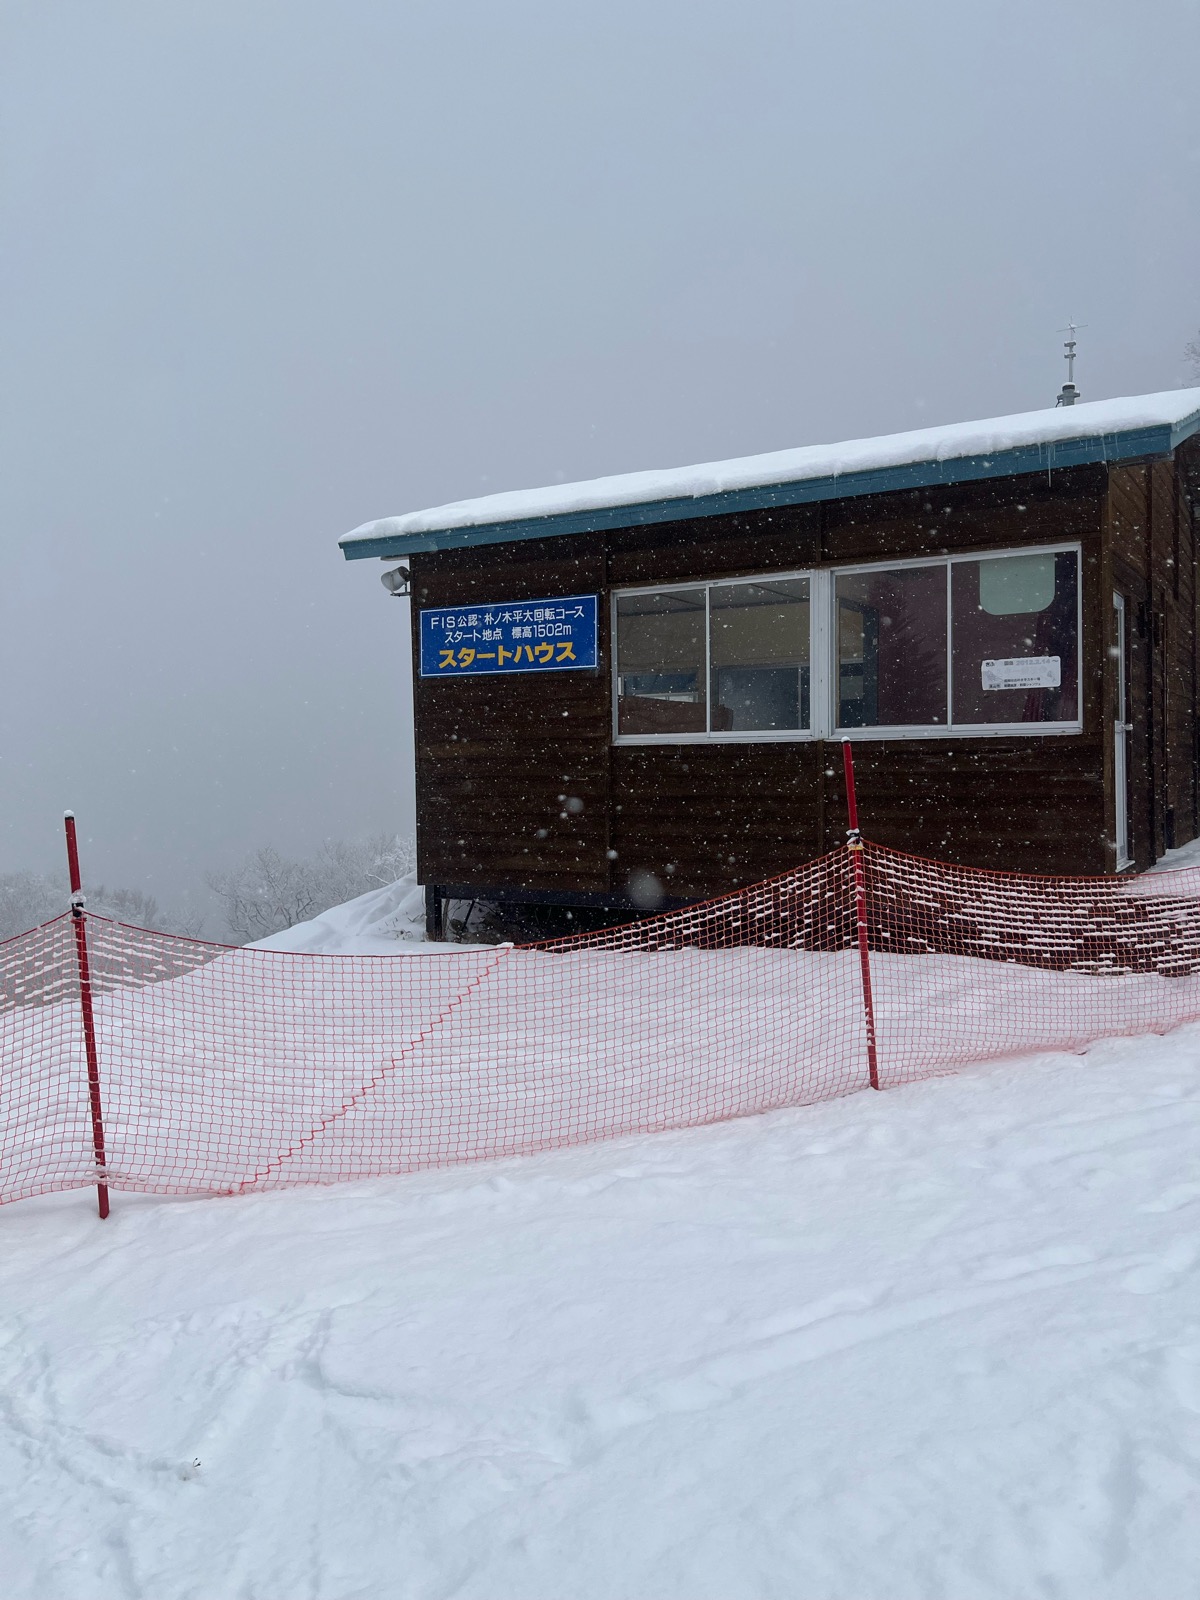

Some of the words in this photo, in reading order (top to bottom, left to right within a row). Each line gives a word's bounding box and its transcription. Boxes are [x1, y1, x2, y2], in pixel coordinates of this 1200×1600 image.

[445, 628, 503, 643] スタート地点
[512, 623, 572, 639] 標高1502m
[439, 641, 577, 669] スタートハウス
